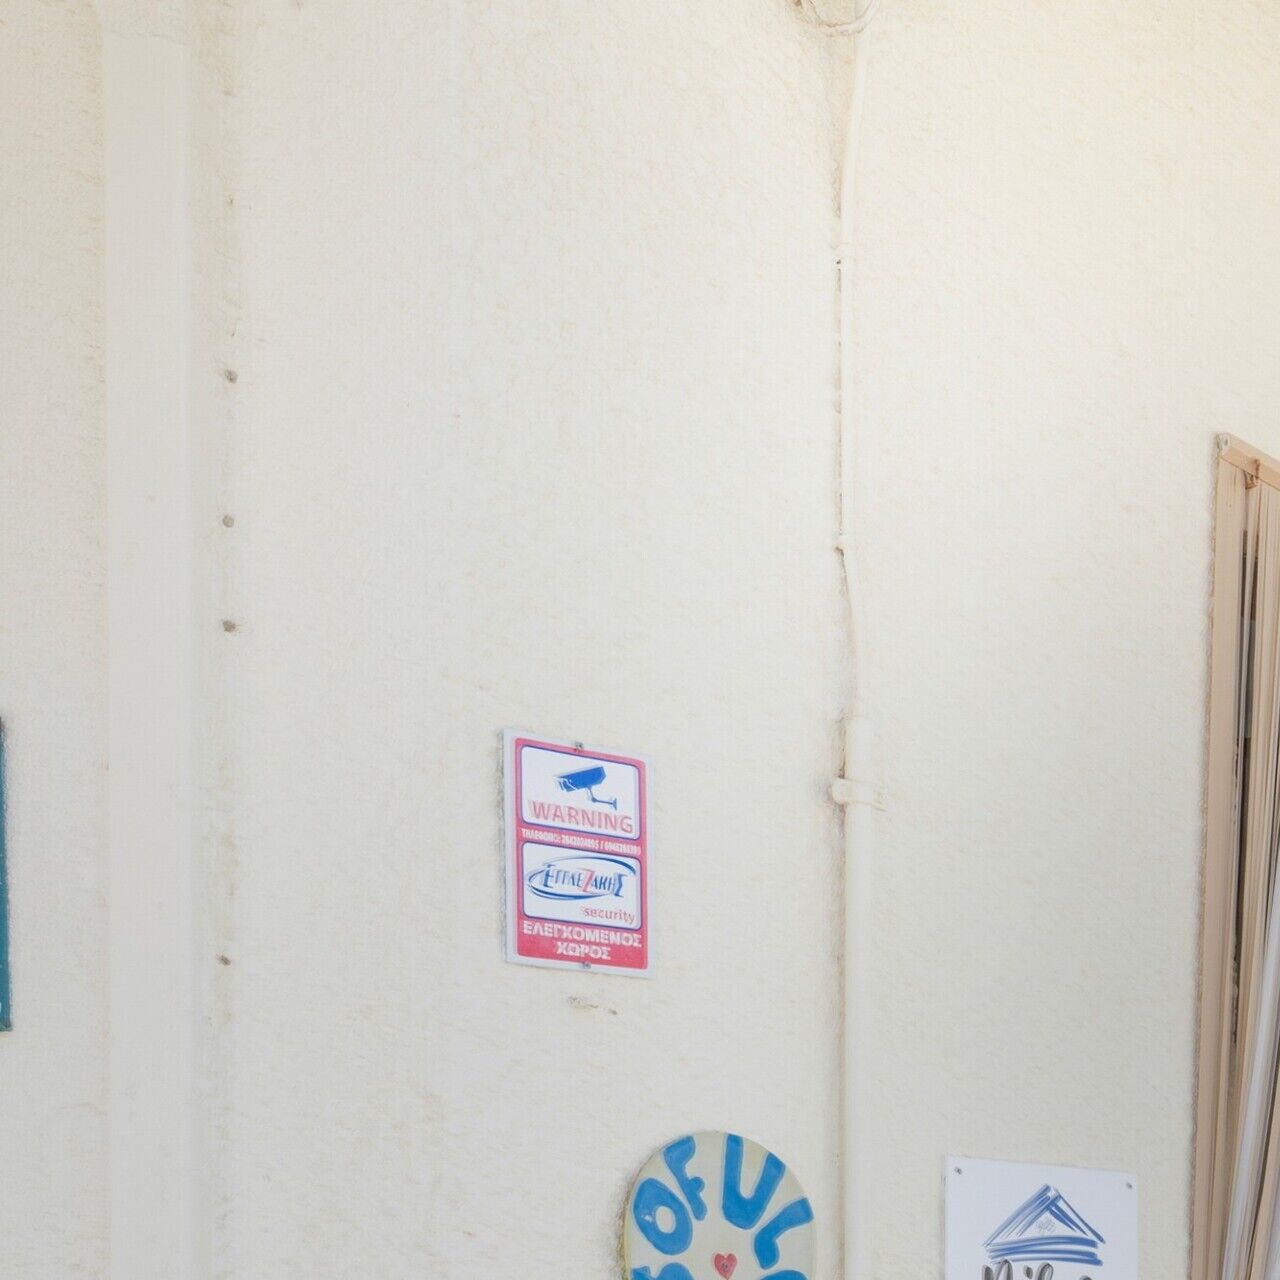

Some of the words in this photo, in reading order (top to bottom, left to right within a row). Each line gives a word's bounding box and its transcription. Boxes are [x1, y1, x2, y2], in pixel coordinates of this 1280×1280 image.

[529, 800, 633, 834] WARNING
[583, 906, 636, 925] security
[523, 920, 642, 947] ΕΛΕΓΧΟΜΕΝΟΣ
[556, 941, 611, 961] ΧΩΡΟΣ
